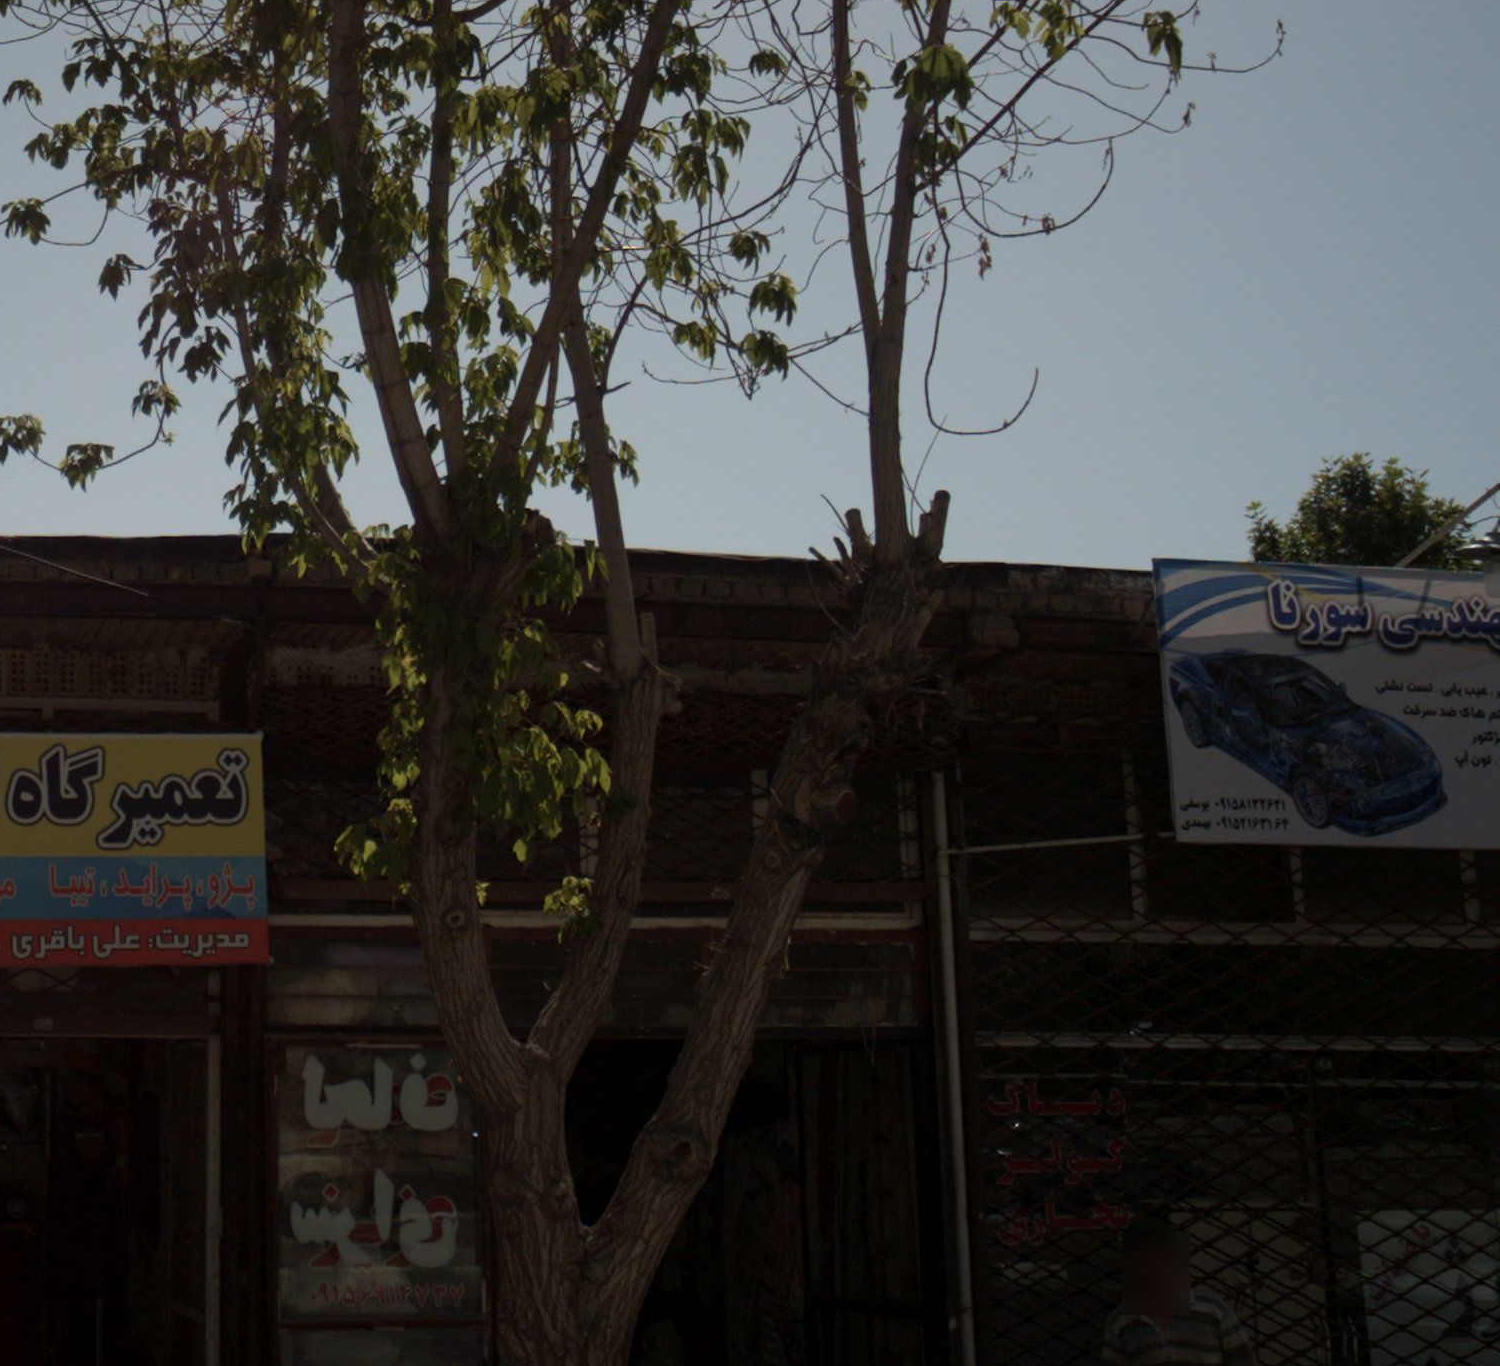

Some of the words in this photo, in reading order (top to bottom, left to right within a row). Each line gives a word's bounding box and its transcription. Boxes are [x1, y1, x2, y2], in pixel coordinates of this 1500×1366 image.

[1268, 580, 1373, 647] سورنا
[1402, 703, 1437, 720] سرقت
[11, 923, 86, 960] باقری
[92, 923, 141, 960] علی
